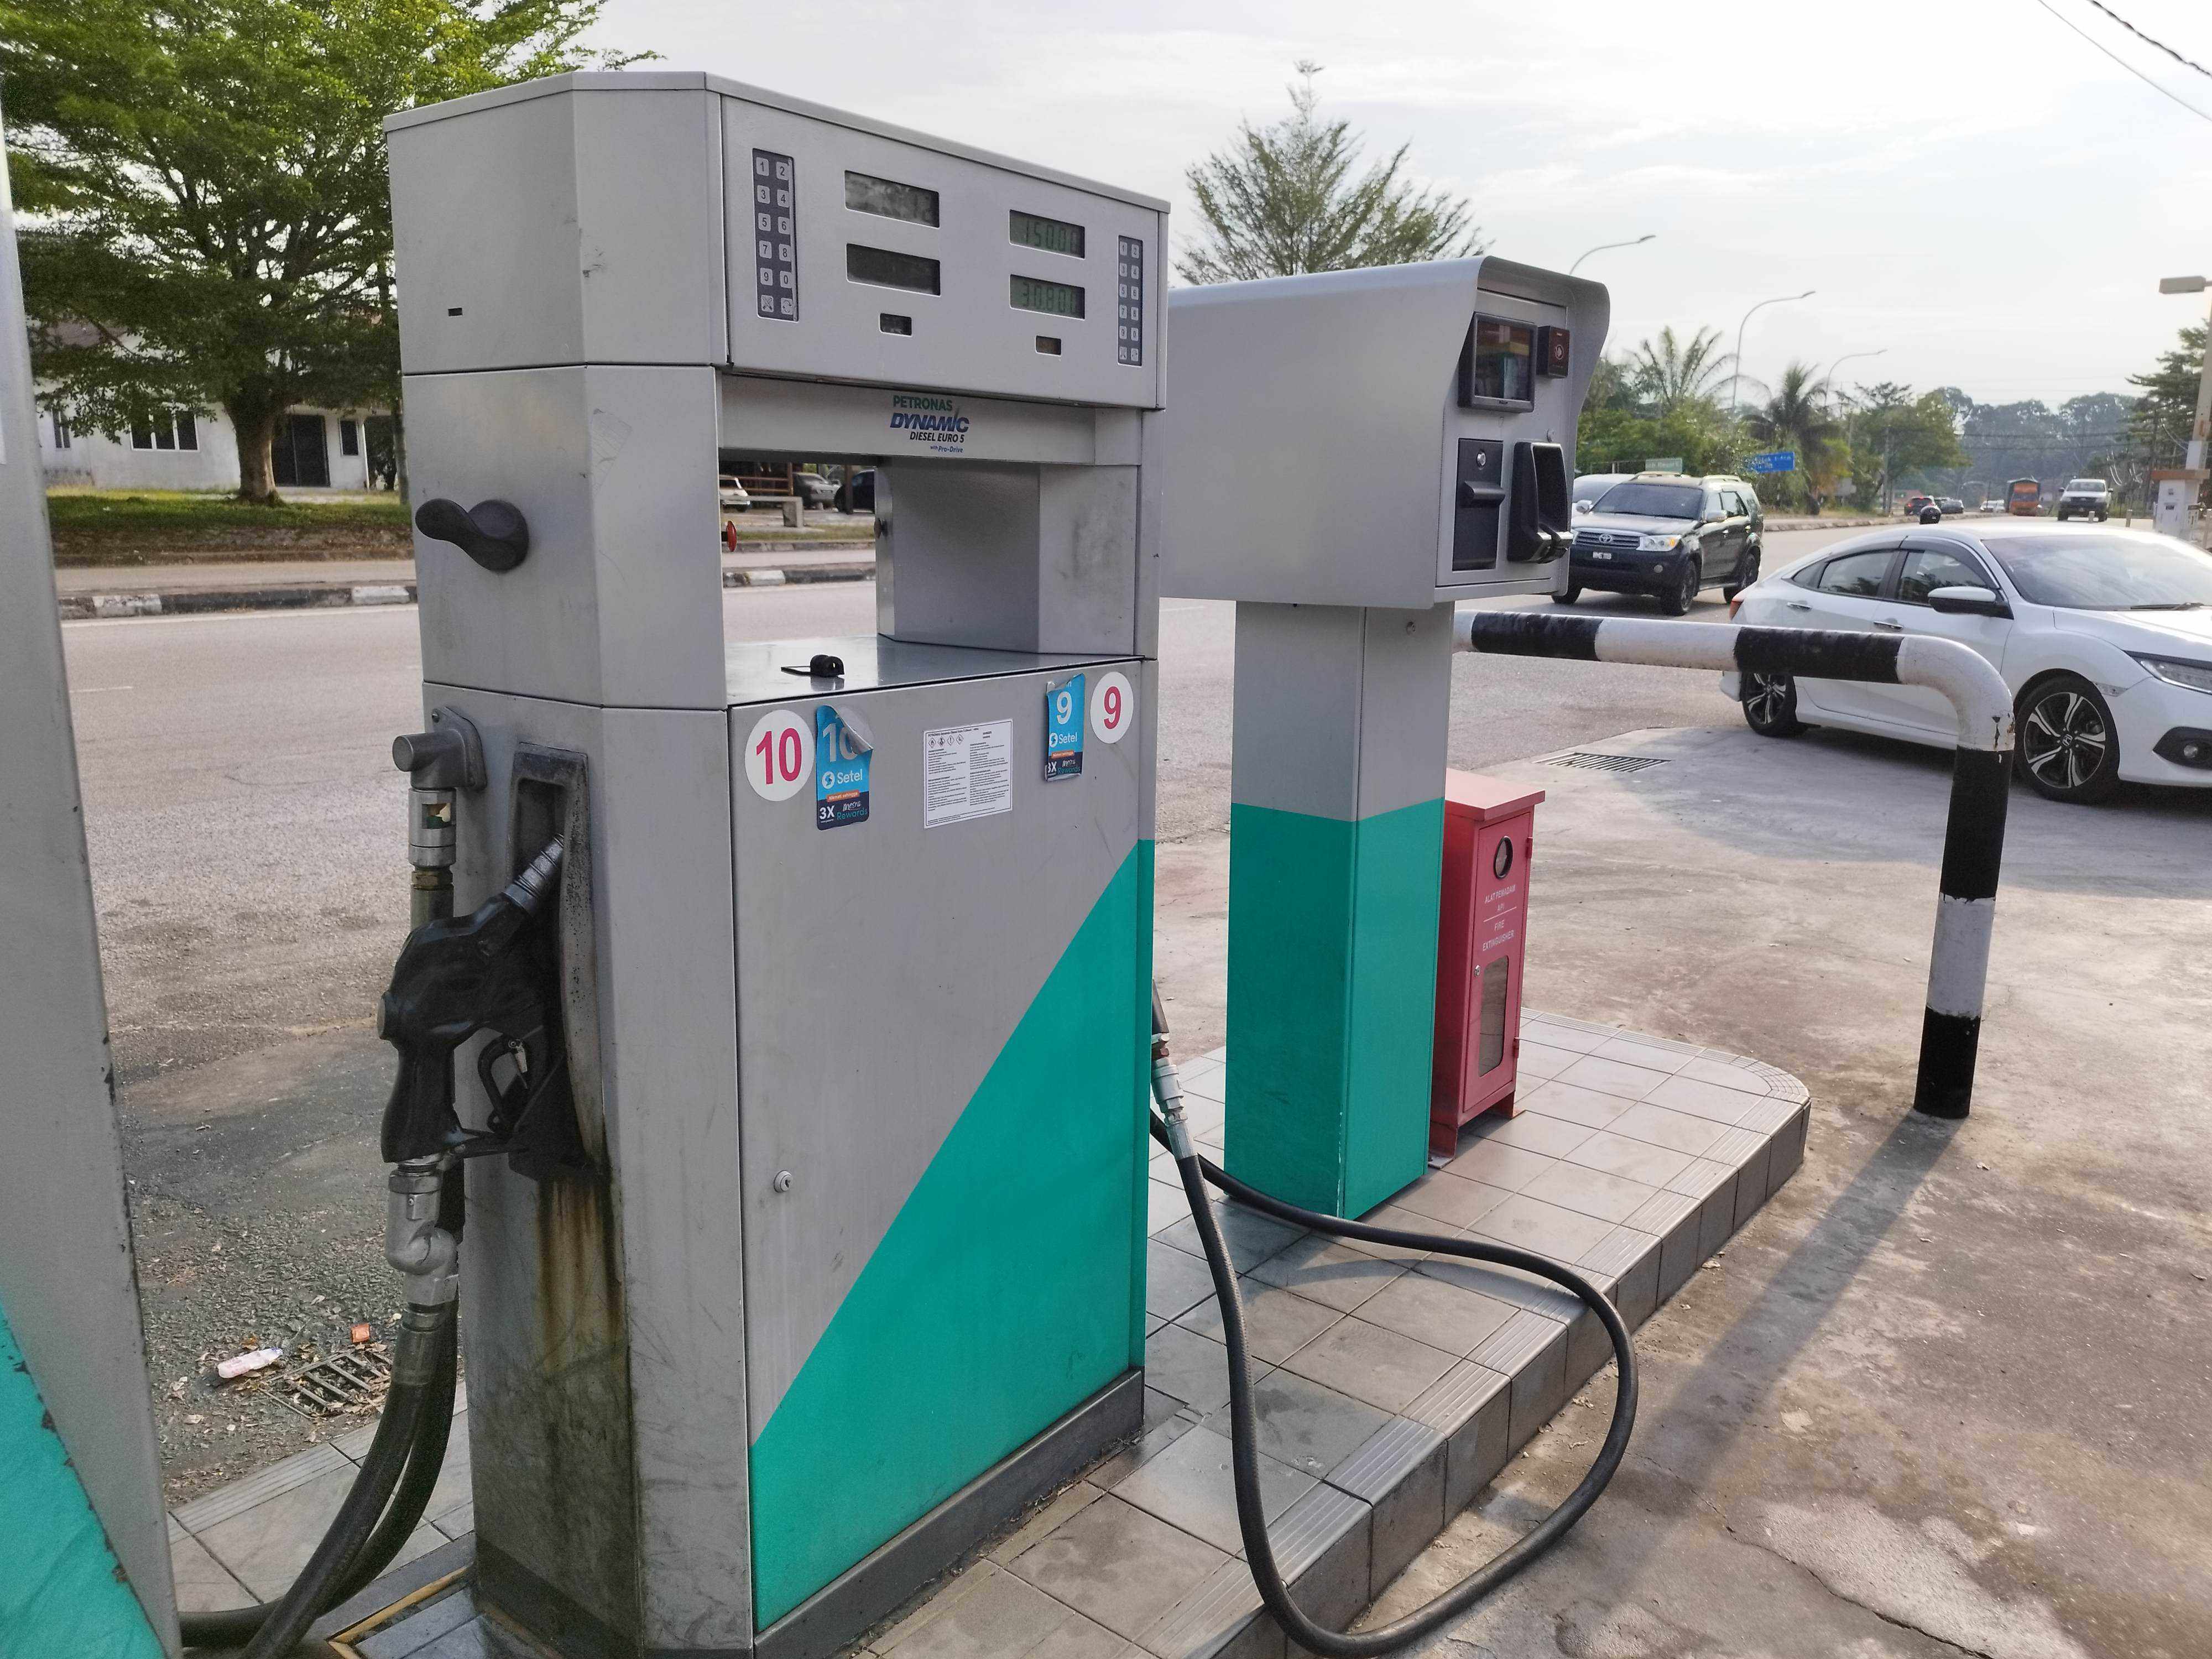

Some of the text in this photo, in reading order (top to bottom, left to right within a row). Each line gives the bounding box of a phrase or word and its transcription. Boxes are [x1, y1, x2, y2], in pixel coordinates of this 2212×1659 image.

[760, 161, 785, 176] 1 2
[761, 189, 786, 203] 3 4
[762, 217, 786, 231] 5 6
[763, 244, 787, 257] 7 8
[764, 272, 788, 284] 9 0
[893, 395, 952, 411] PETRONAS
[890, 408, 969, 433] DYNAMIC
[910, 431, 964, 443] DIESEL EURO 5
[1056, 691, 1072, 724] 9
[1103, 686, 1121, 729] 9
[1059, 732, 1077, 744] Setel
[756, 728, 802, 785] 10
[837, 769, 863, 785] Setel
[1058, 765, 1080, 774] Rewards
[820, 805, 835, 820] 3X
[837, 808, 868, 820] Rewards
[1484, 884, 1516, 904] ALAT PEMADAM
[1494, 919, 1505, 931] FIRE
[1483, 929, 1514, 951] EXTINGUISHER
